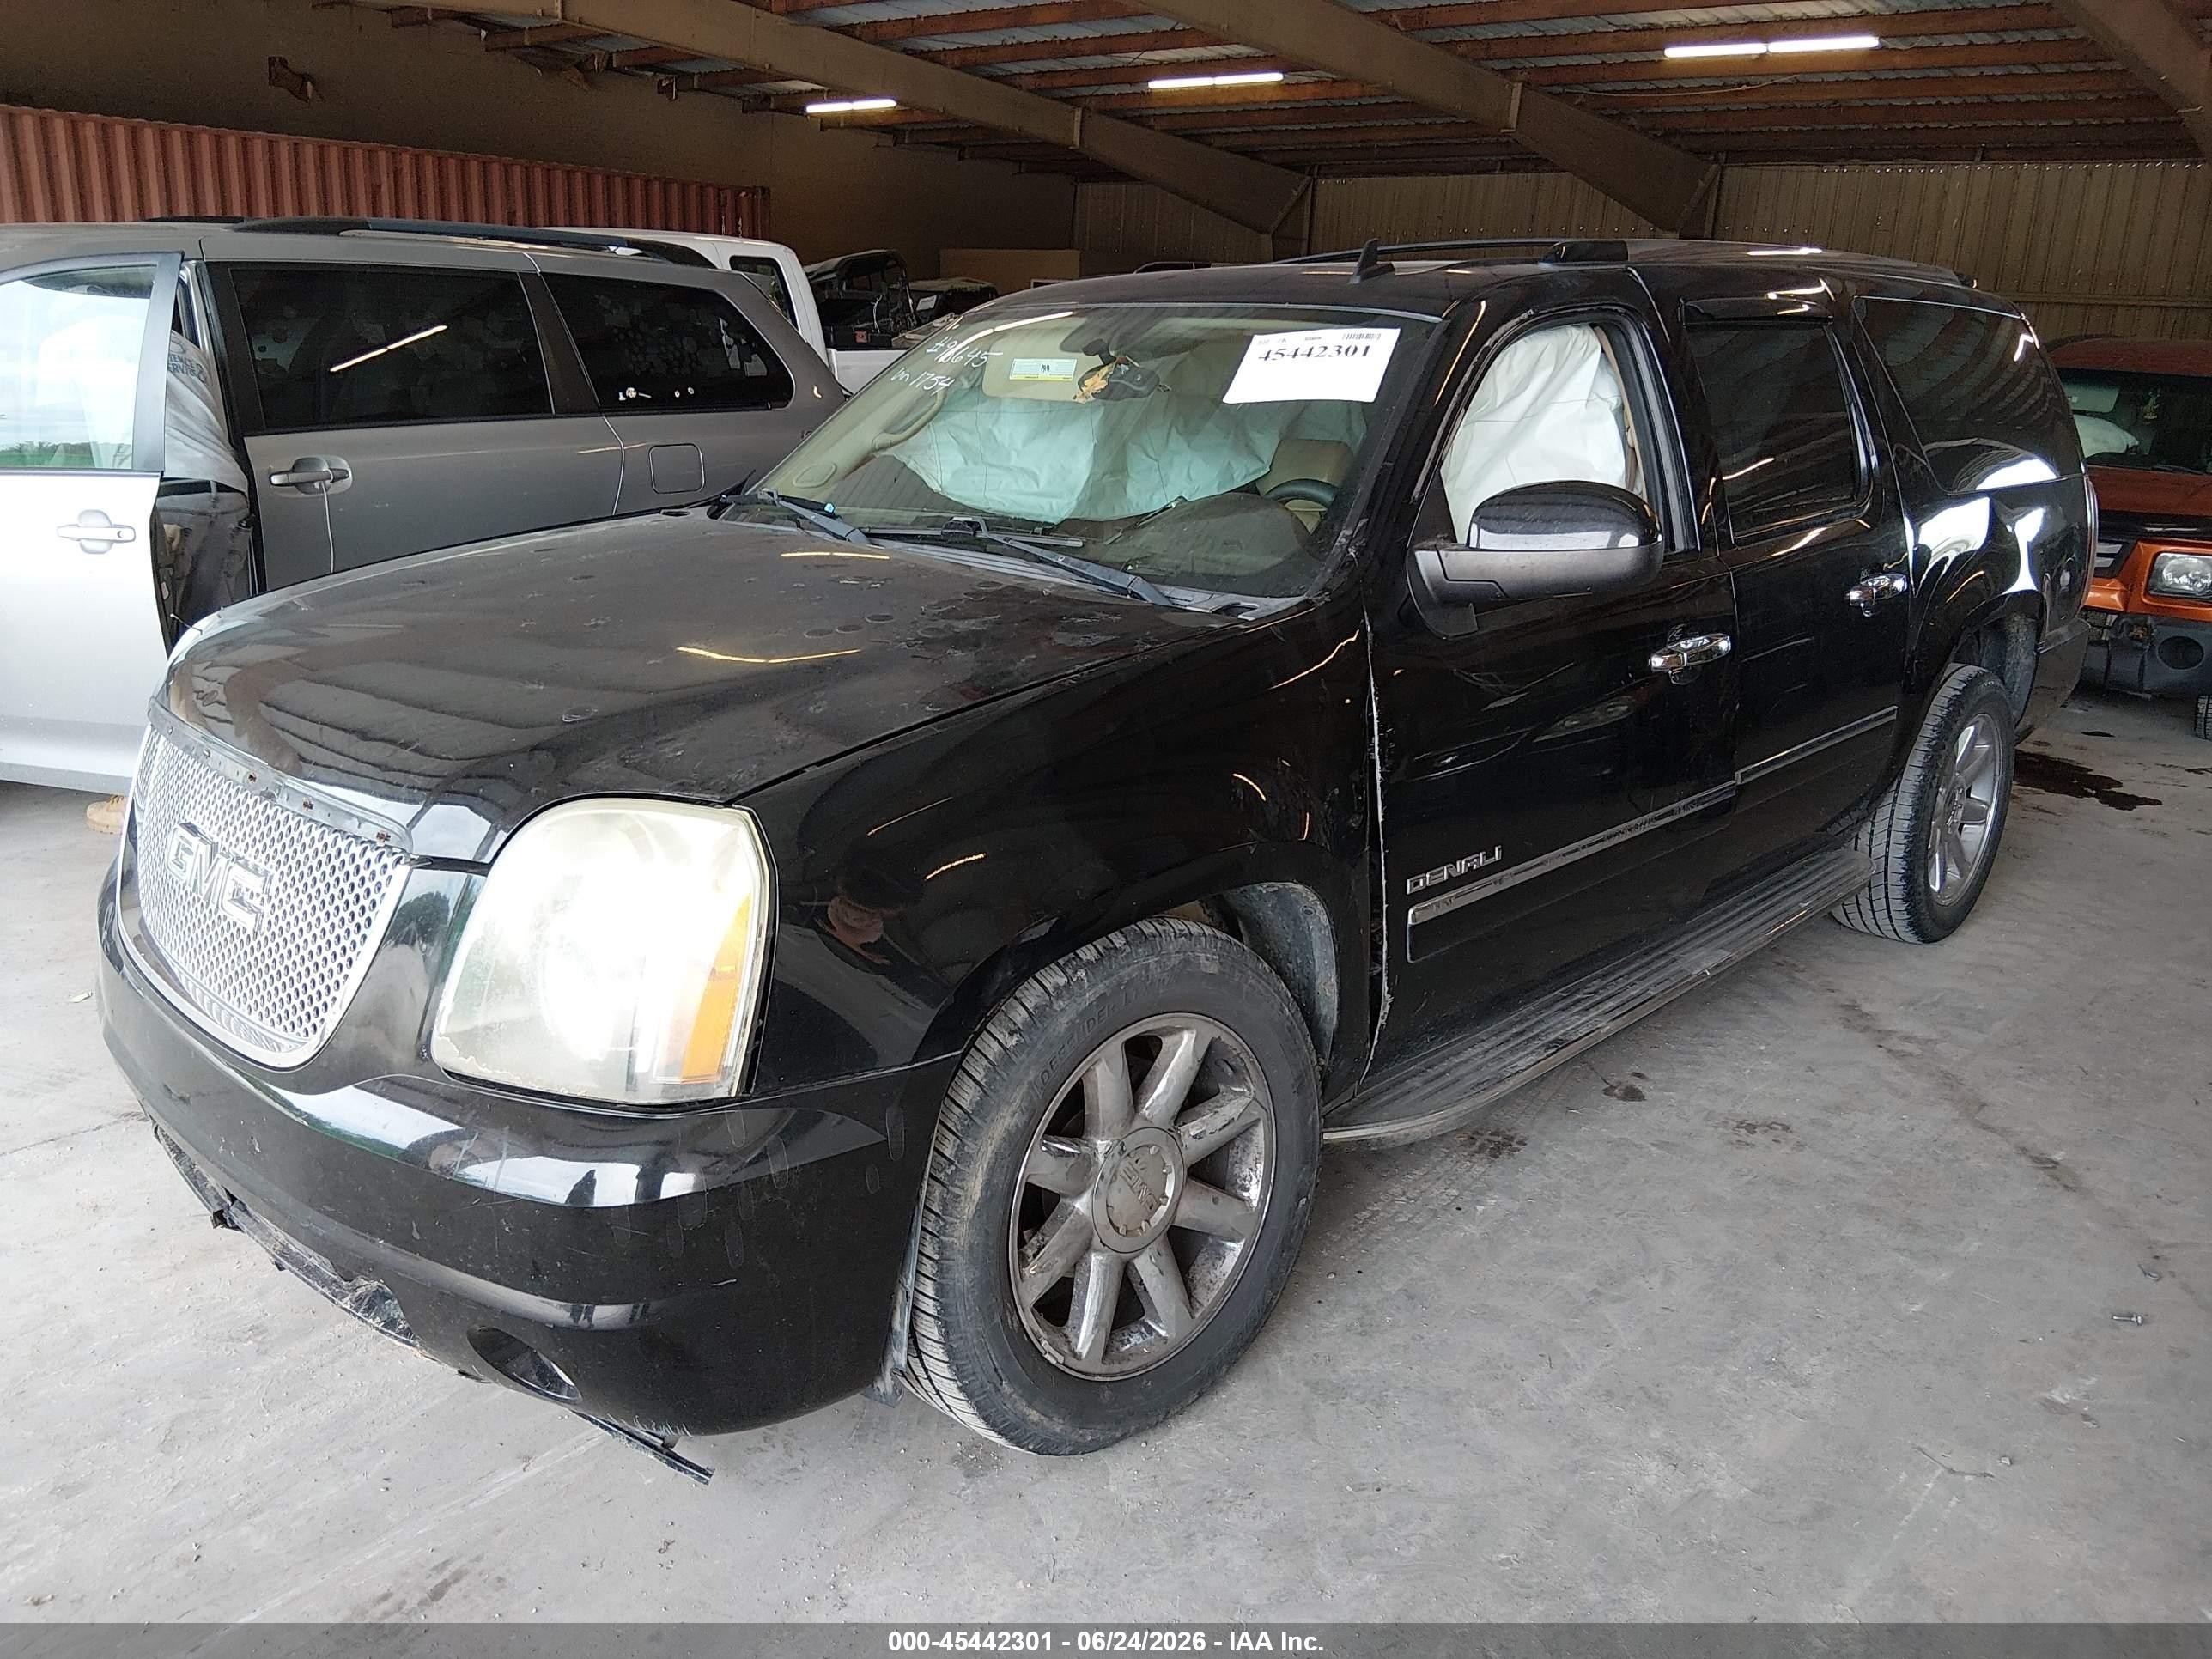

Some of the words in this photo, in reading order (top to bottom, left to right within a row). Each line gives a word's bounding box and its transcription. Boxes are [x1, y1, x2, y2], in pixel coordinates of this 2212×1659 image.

[1258, 344, 1370, 361] 45442301
[166, 822, 275, 933] GMC
[1407, 844, 1502, 895] DENALI
